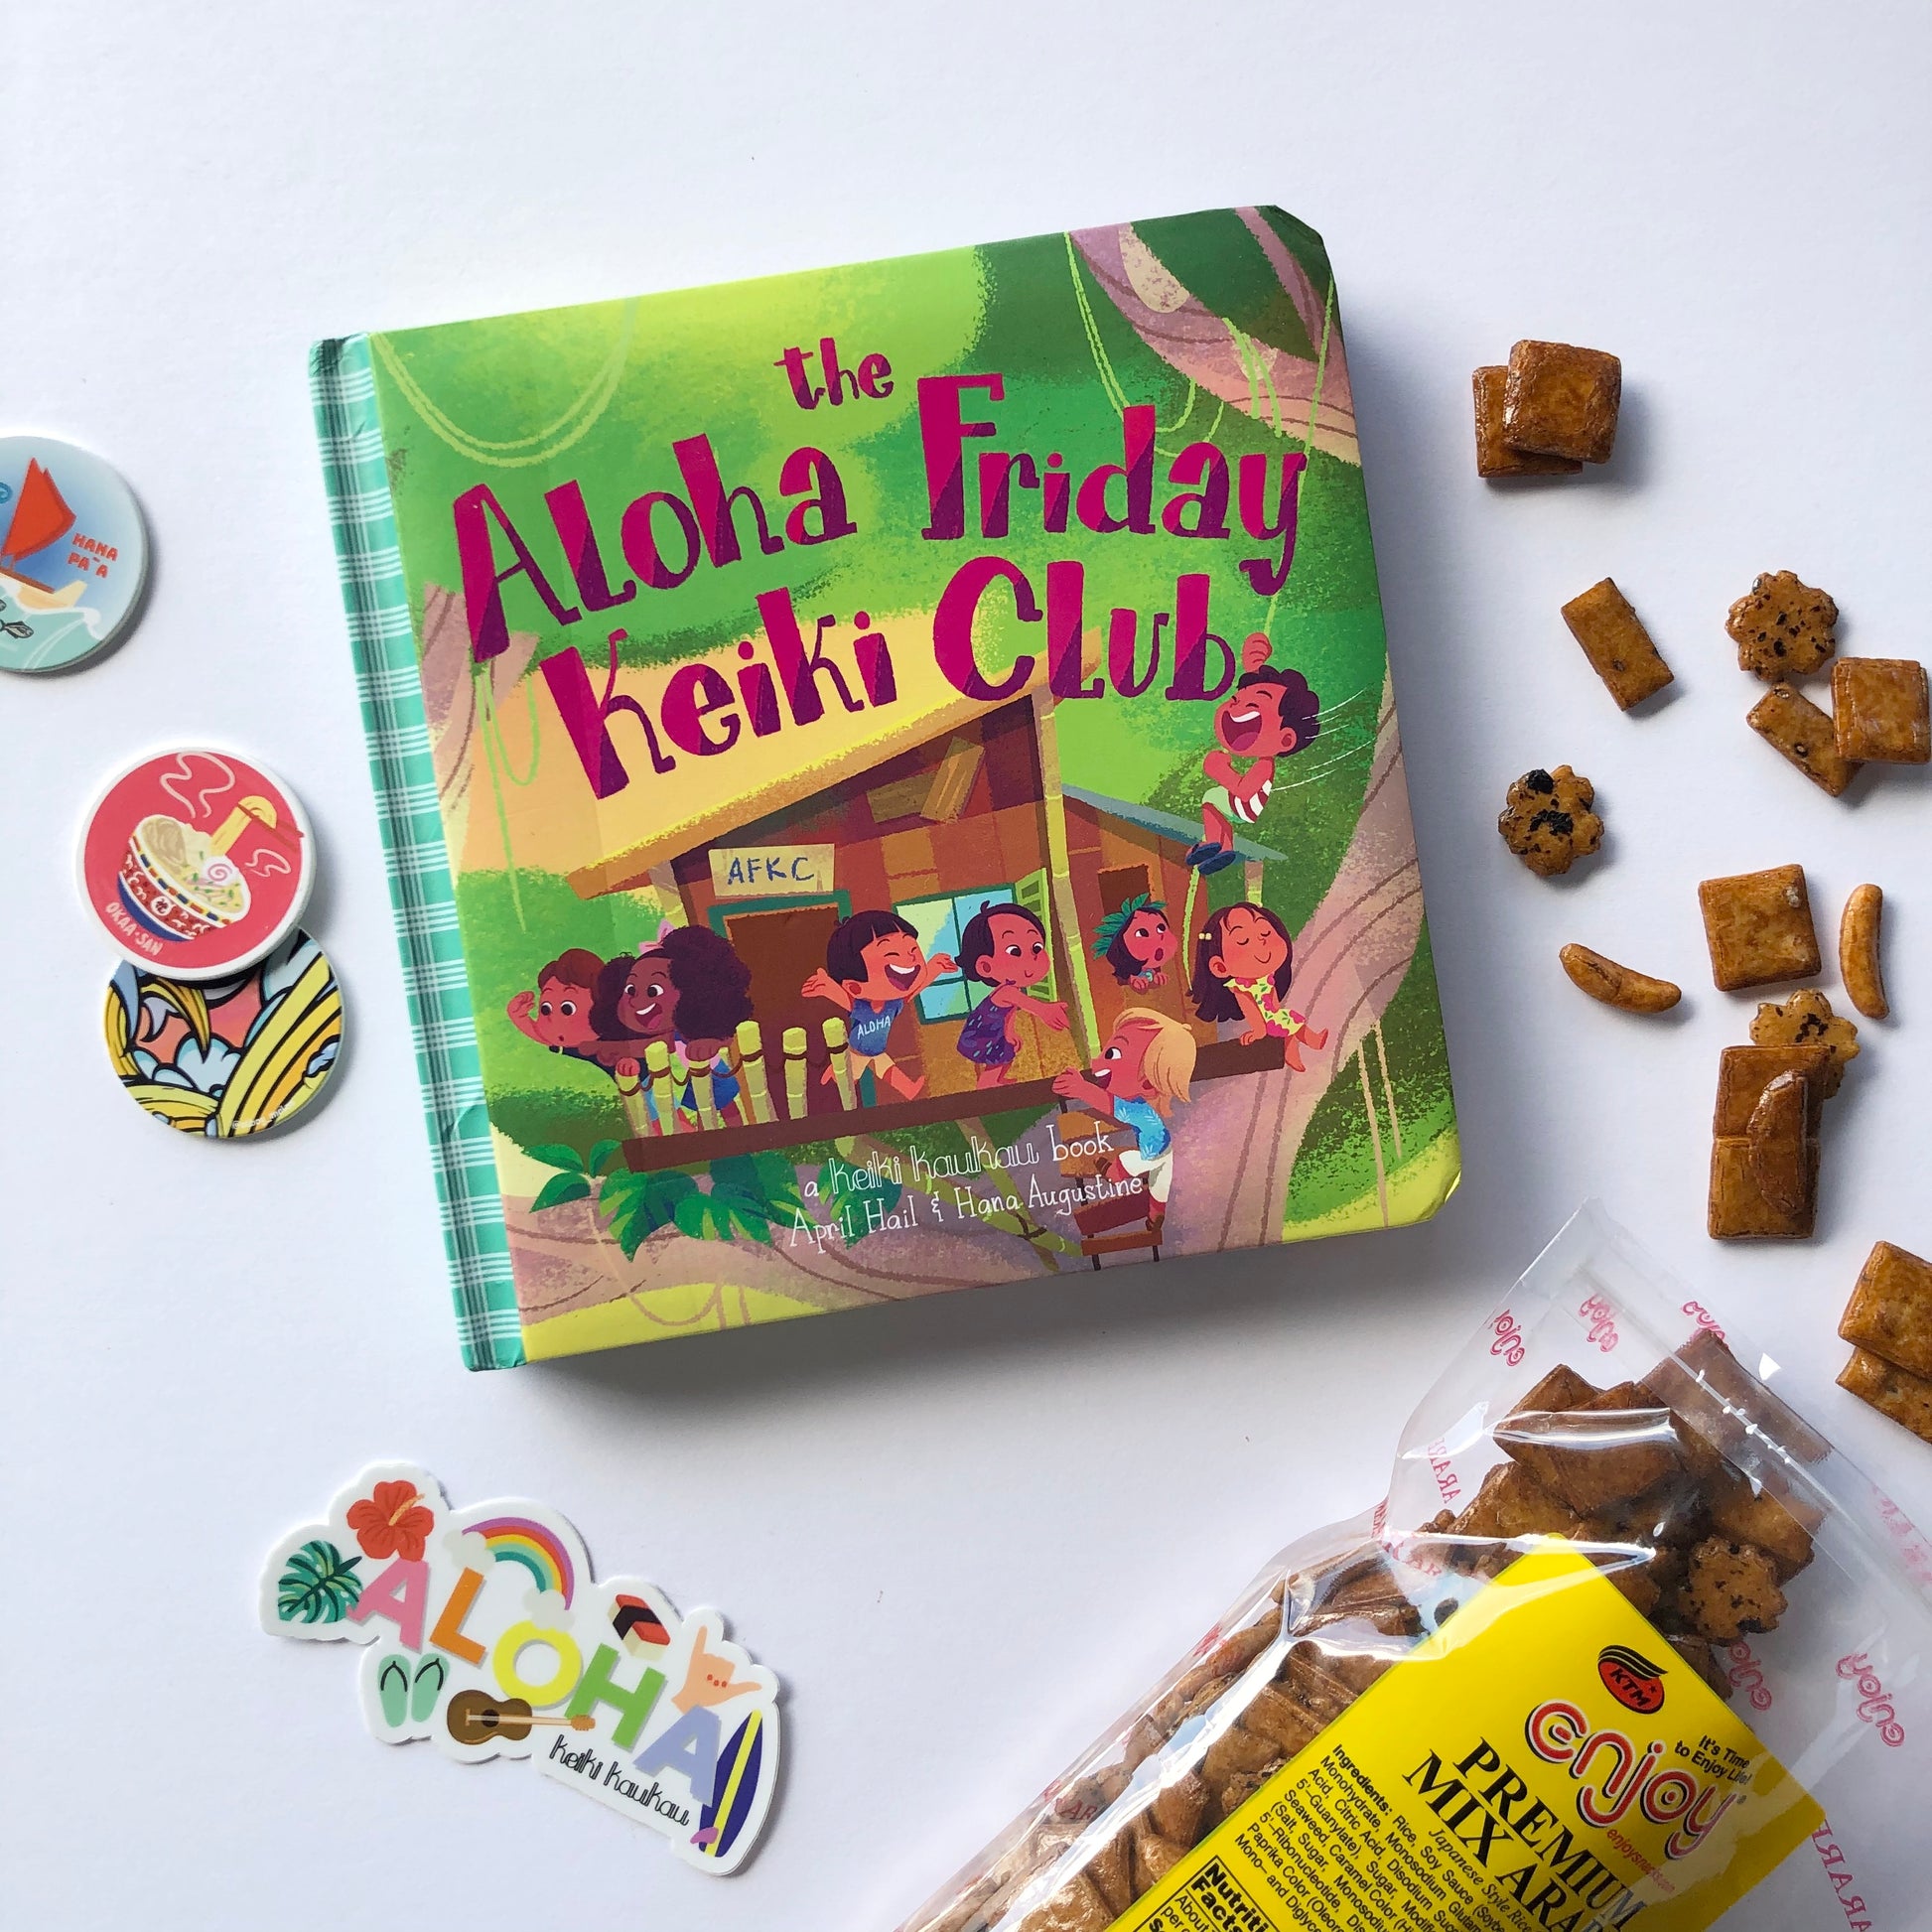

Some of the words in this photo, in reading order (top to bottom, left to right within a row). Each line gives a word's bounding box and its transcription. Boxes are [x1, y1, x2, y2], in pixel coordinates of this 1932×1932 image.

[774, 338, 895, 411] the
[916, 373, 1308, 595] Friday
[71, 532, 118, 562] HANA
[539, 587, 899, 801] Keiki
[932, 555, 1236, 704] Club
[727, 857, 814, 885] AFKC
[857, 1015, 892, 1040] ALOHA
[804, 1179, 819, 1196] a
[1045, 1121, 1114, 1161] book
[790, 1205, 856, 1254] April
[863, 1195, 917, 1234] Hail
[931, 1191, 943, 1223] &
[954, 1186, 1020, 1220] Hana
[1029, 1173, 1143, 1215] Augustine
[346, 1557, 723, 1806] ALOHA
[1609, 1668, 1651, 1707] KTM
[1524, 1699, 1737, 1861] enjoy
[1674, 1739, 1690, 1757] to
[1692, 1750, 1727, 1779] Enjoy
[1698, 1734, 1721, 1756] It's
[1723, 1747, 1750, 1768] Time
[1270, 1801, 1298, 1835] (Salt,
[1298, 1832, 1329, 1872] Sugar,
[1308, 1768, 1334, 1800] Acid,
[1334, 1798, 1361, 1831] Citric
[1358, 1830, 1387, 1861] Acid,
[1386, 1858, 1434, 1911] Disodium
[1320, 1755, 1381, 1833] Monohydrate,
[1385, 1831, 1448, 1901] Monosodium
[1332, 1744, 1393, 1817] Ingredients:
[1392, 1815, 1417, 1848] Rice,
[1420, 1846, 1443, 1870] Soy
[1442, 1869, 1474, 1905] Sauce
[1402, 1748, 1514, 1868] MIX
[1452, 1736, 1648, 1932] PREMIUM
[1247, 1822, 1284, 1868] Paprika
[1282, 1865, 1311, 1898] Color
[1266, 1874, 1291, 1899] and
[1284, 1789, 1330, 1848] Seaweed,
[1329, 1844, 1373, 1893] Caramel
[1368, 1888, 1398, 1920] Color
[1366, 1861, 1398, 1900] Sugar,
[1428, 1829, 1484, 1886] Japanese
[1481, 1883, 1511, 1913] Style
[1506, 1908, 1533, 1932] Rice
[1160, 1905, 1184, 1929] per
[1173, 1895, 1210, 1932] About
